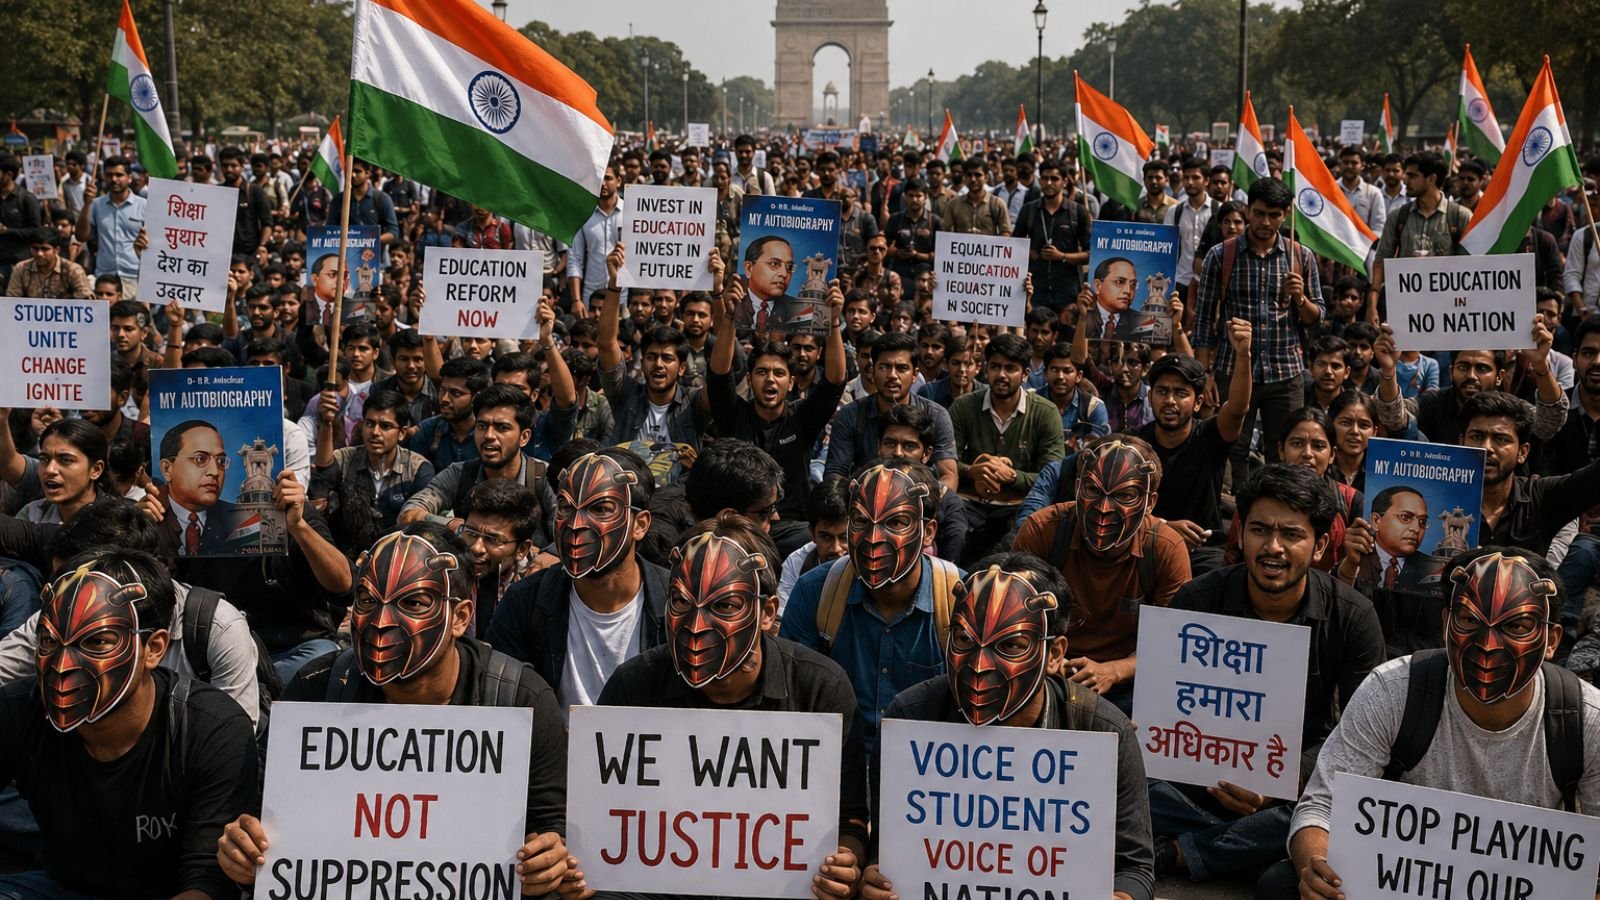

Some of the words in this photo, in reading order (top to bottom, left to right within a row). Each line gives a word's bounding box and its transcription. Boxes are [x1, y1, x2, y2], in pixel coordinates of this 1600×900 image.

[167, 194, 207, 221] शिक्षा
[637, 198, 685, 214] INVEST
[689, 200, 703, 215] IN
[632, 220, 705, 236] EDUCATION
[748, 213, 762, 226] MY
[764, 214, 834, 232] AUTOBIOGRAPHY
[635, 241, 683, 256] INVEST
[687, 244, 701, 258] IN
[1097, 237, 1109, 249] MY
[157, 250, 183, 274] देश
[187, 259, 209, 277] का
[438, 258, 527, 278] EDUCATION
[639, 262, 693, 278] FUTURE
[942, 261, 954, 273] IN
[957, 262, 1020, 279] EDUCATION
[999, 285, 1012, 297] IN
[1398, 273, 1422, 293] NO
[1429, 269, 1522, 292] EDUCATION
[446, 283, 516, 303] REFORM
[1454, 297, 1467, 307] IN
[14, 304, 94, 324] STUDENTS
[457, 309, 499, 328] NOW
[960, 301, 1009, 317] SOCIETY
[1408, 313, 1435, 333] NO
[1443, 311, 1516, 333] NATION
[28, 330, 78, 349] UNITE
[22, 356, 87, 375] CHANGE
[26, 383, 83, 401] IGNITE
[159, 392, 176, 409] MY
[181, 390, 273, 409] AUTOBIOGRAPHY
[1374, 459, 1390, 475] MY
[1393, 462, 1475, 484] AUTOBIOGRAPHY
[1178, 623, 1267, 675] शिक्षा
[1175, 681, 1266, 723] हमारा
[300, 726, 504, 774] EDUCATION
[1146, 720, 1258, 772] अधिकार
[1266, 733, 1288, 779] है
[595, 732, 662, 787] WE
[688, 735, 820, 790] WANT
[910, 740, 1015, 781] VOICE
[1032, 748, 1078, 785] OF
[354, 793, 438, 839] NOT
[906, 789, 1090, 834] STUDENTS
[600, 809, 810, 871] JUSTICE
[1354, 796, 1441, 845] STOP
[1451, 812, 1585, 871] PLAYING
[923, 838, 1013, 875] VOICE
[1027, 845, 1067, 877] OF
[268, 858, 515, 900] SUPPRESSION
[1377, 853, 1454, 900] WITH
[1467, 870, 1534, 900] OUR
